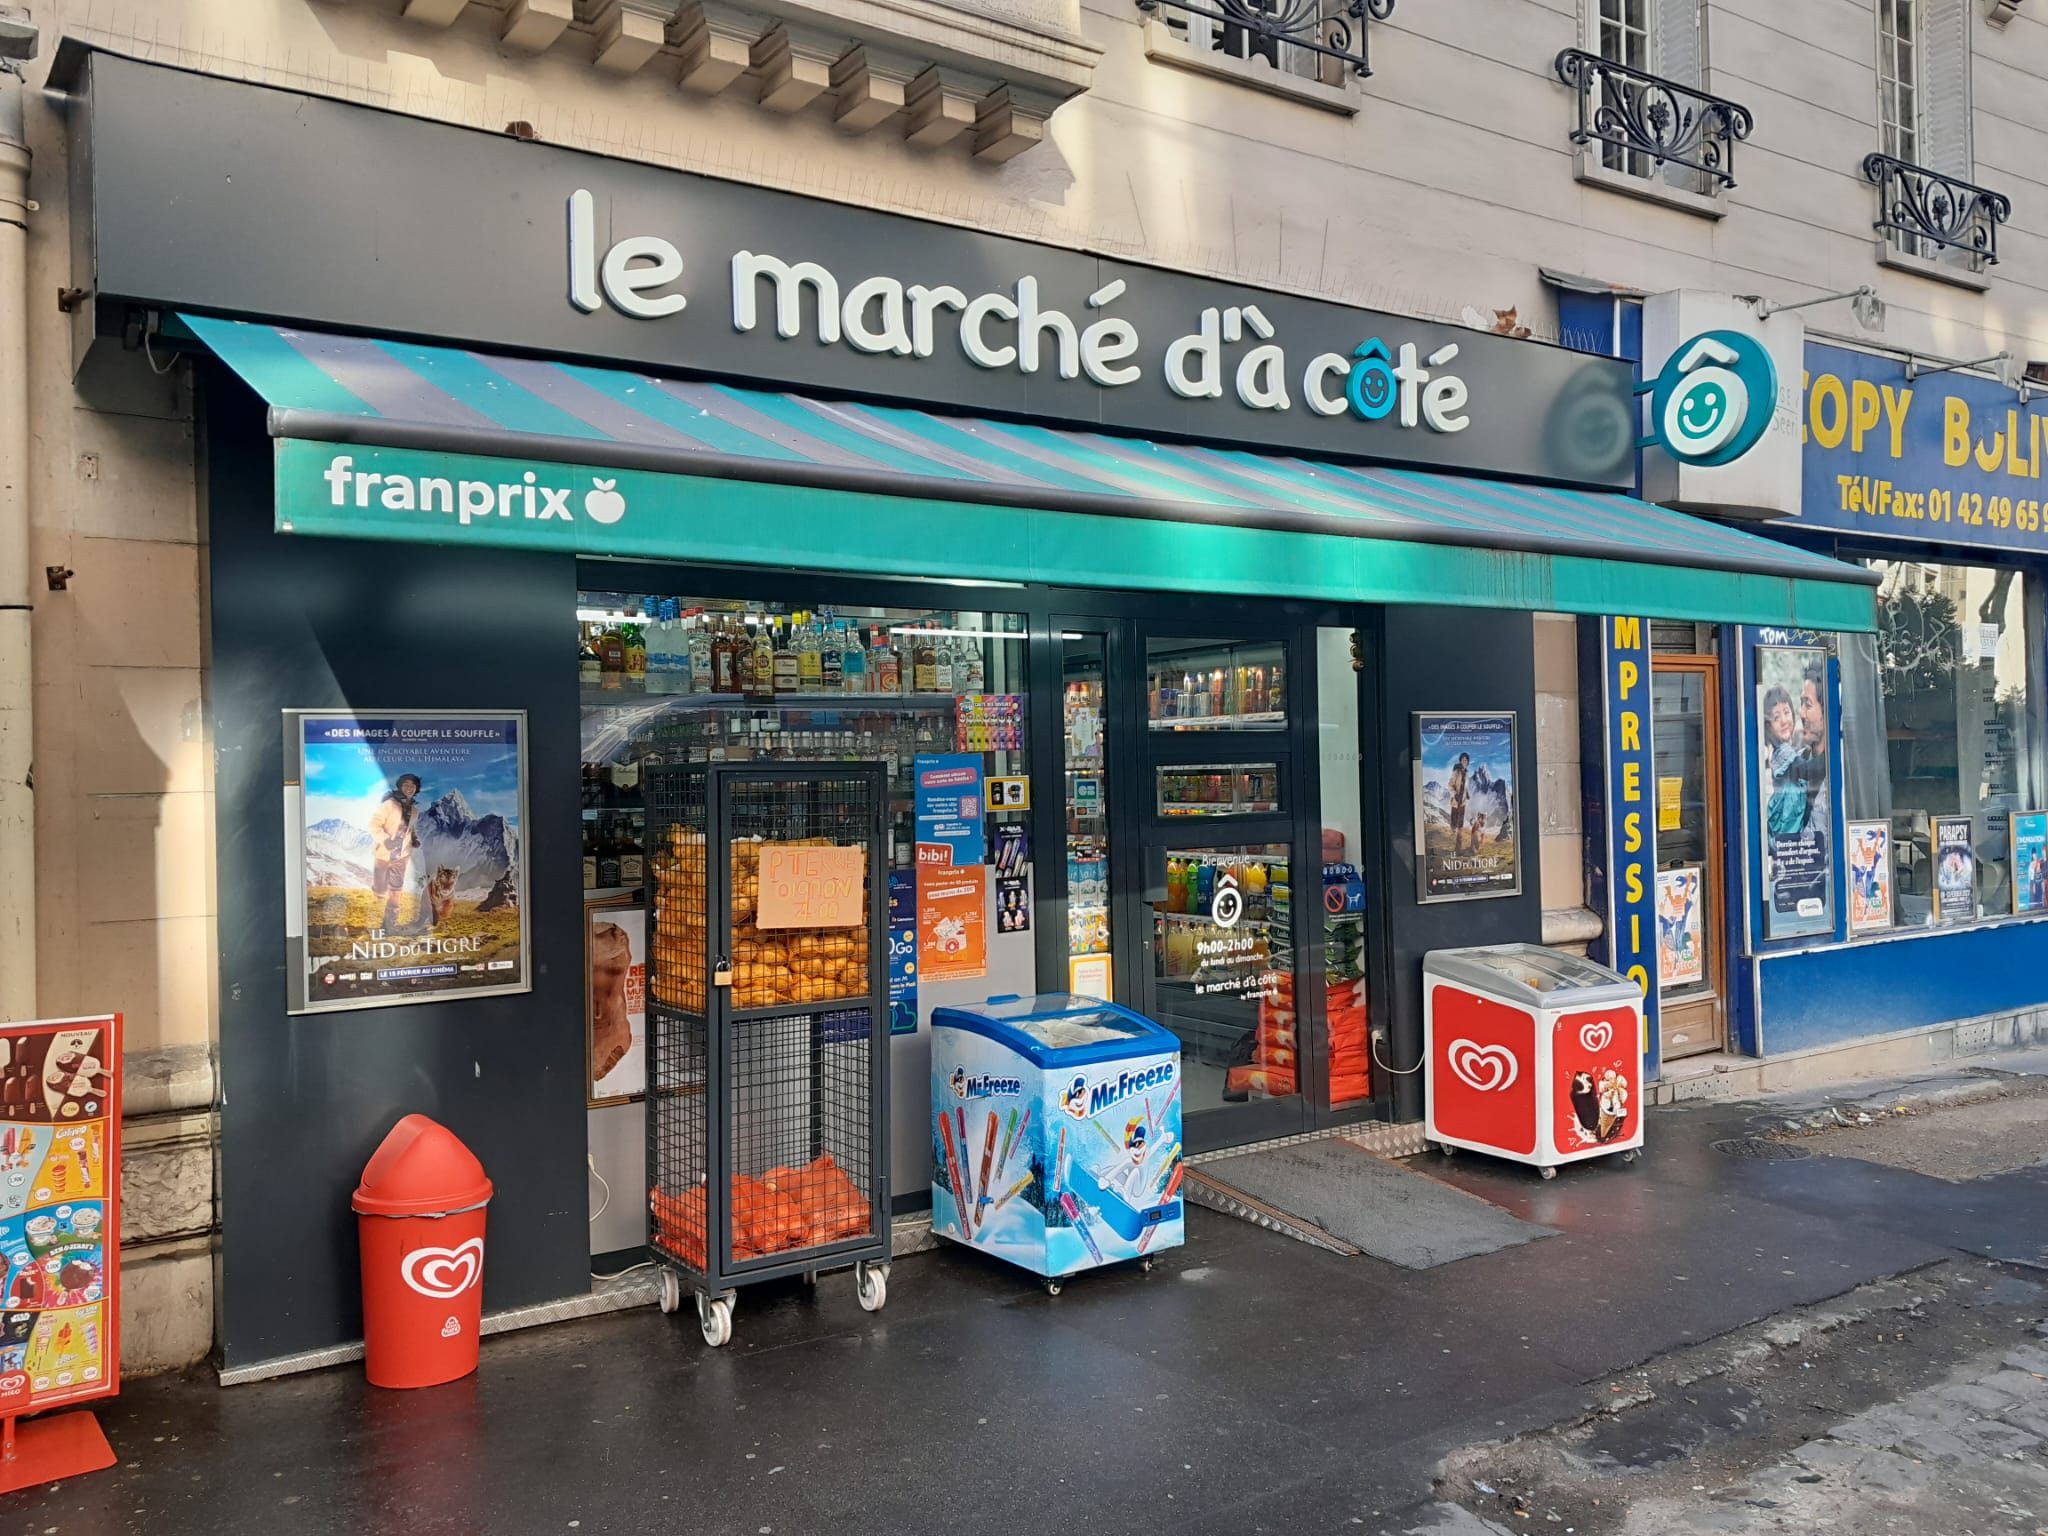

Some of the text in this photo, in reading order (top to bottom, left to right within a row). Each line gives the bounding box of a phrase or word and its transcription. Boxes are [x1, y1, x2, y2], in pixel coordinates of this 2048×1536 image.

[571, 189, 1470, 434] le marché d'à côté
[1802, 371, 1914, 459] OPY
[323, 455, 574, 525] franprix
[1928, 488, 1952, 524] 01
[1957, 491, 1984, 527] 42
[1986, 495, 2012, 530] 49
[2015, 499, 2040, 534] 65
[1759, 626, 1788, 645] TOM
[353, 728, 390, 738] IMAGES
[401, 729, 439, 738] COUPER
[441, 729, 452, 738] LE
[1939, 824, 1968, 841] PARAPSY
[919, 848, 948, 862] bibi!
[1202, 854, 1250, 867] Bienvenue
[372, 929, 385, 940] LE
[352, 942, 396, 960] NID
[424, 936, 481, 955] TIGRE
[1197, 937, 1254, 955] 9h00-2h00
[1235, 952, 1264, 963] dimanche
[1195, 983, 1204, 995] le
[1206, 976, 1241, 993] marché
[1258, 972, 1277, 985] côté
